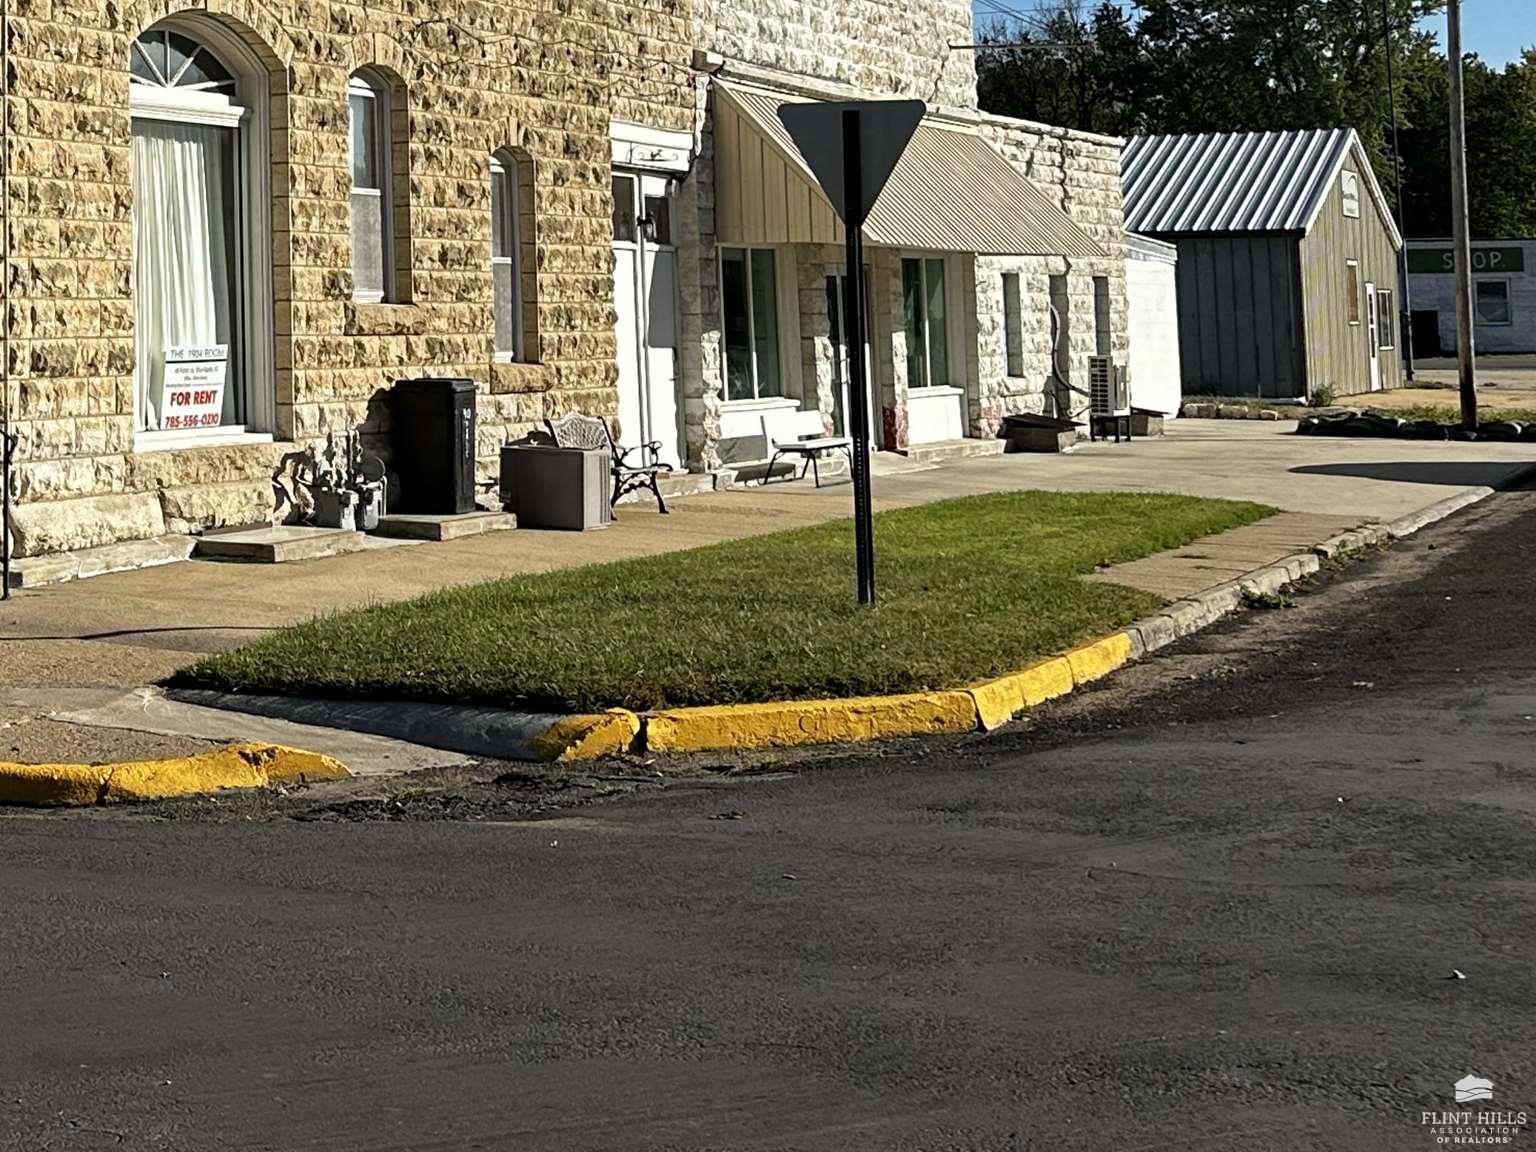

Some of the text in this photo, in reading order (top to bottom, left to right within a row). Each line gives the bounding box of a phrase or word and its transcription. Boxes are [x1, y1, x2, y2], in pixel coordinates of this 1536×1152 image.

[170, 390, 218, 407] FOR RENT
[165, 413, 219, 428] 785-556-0210
